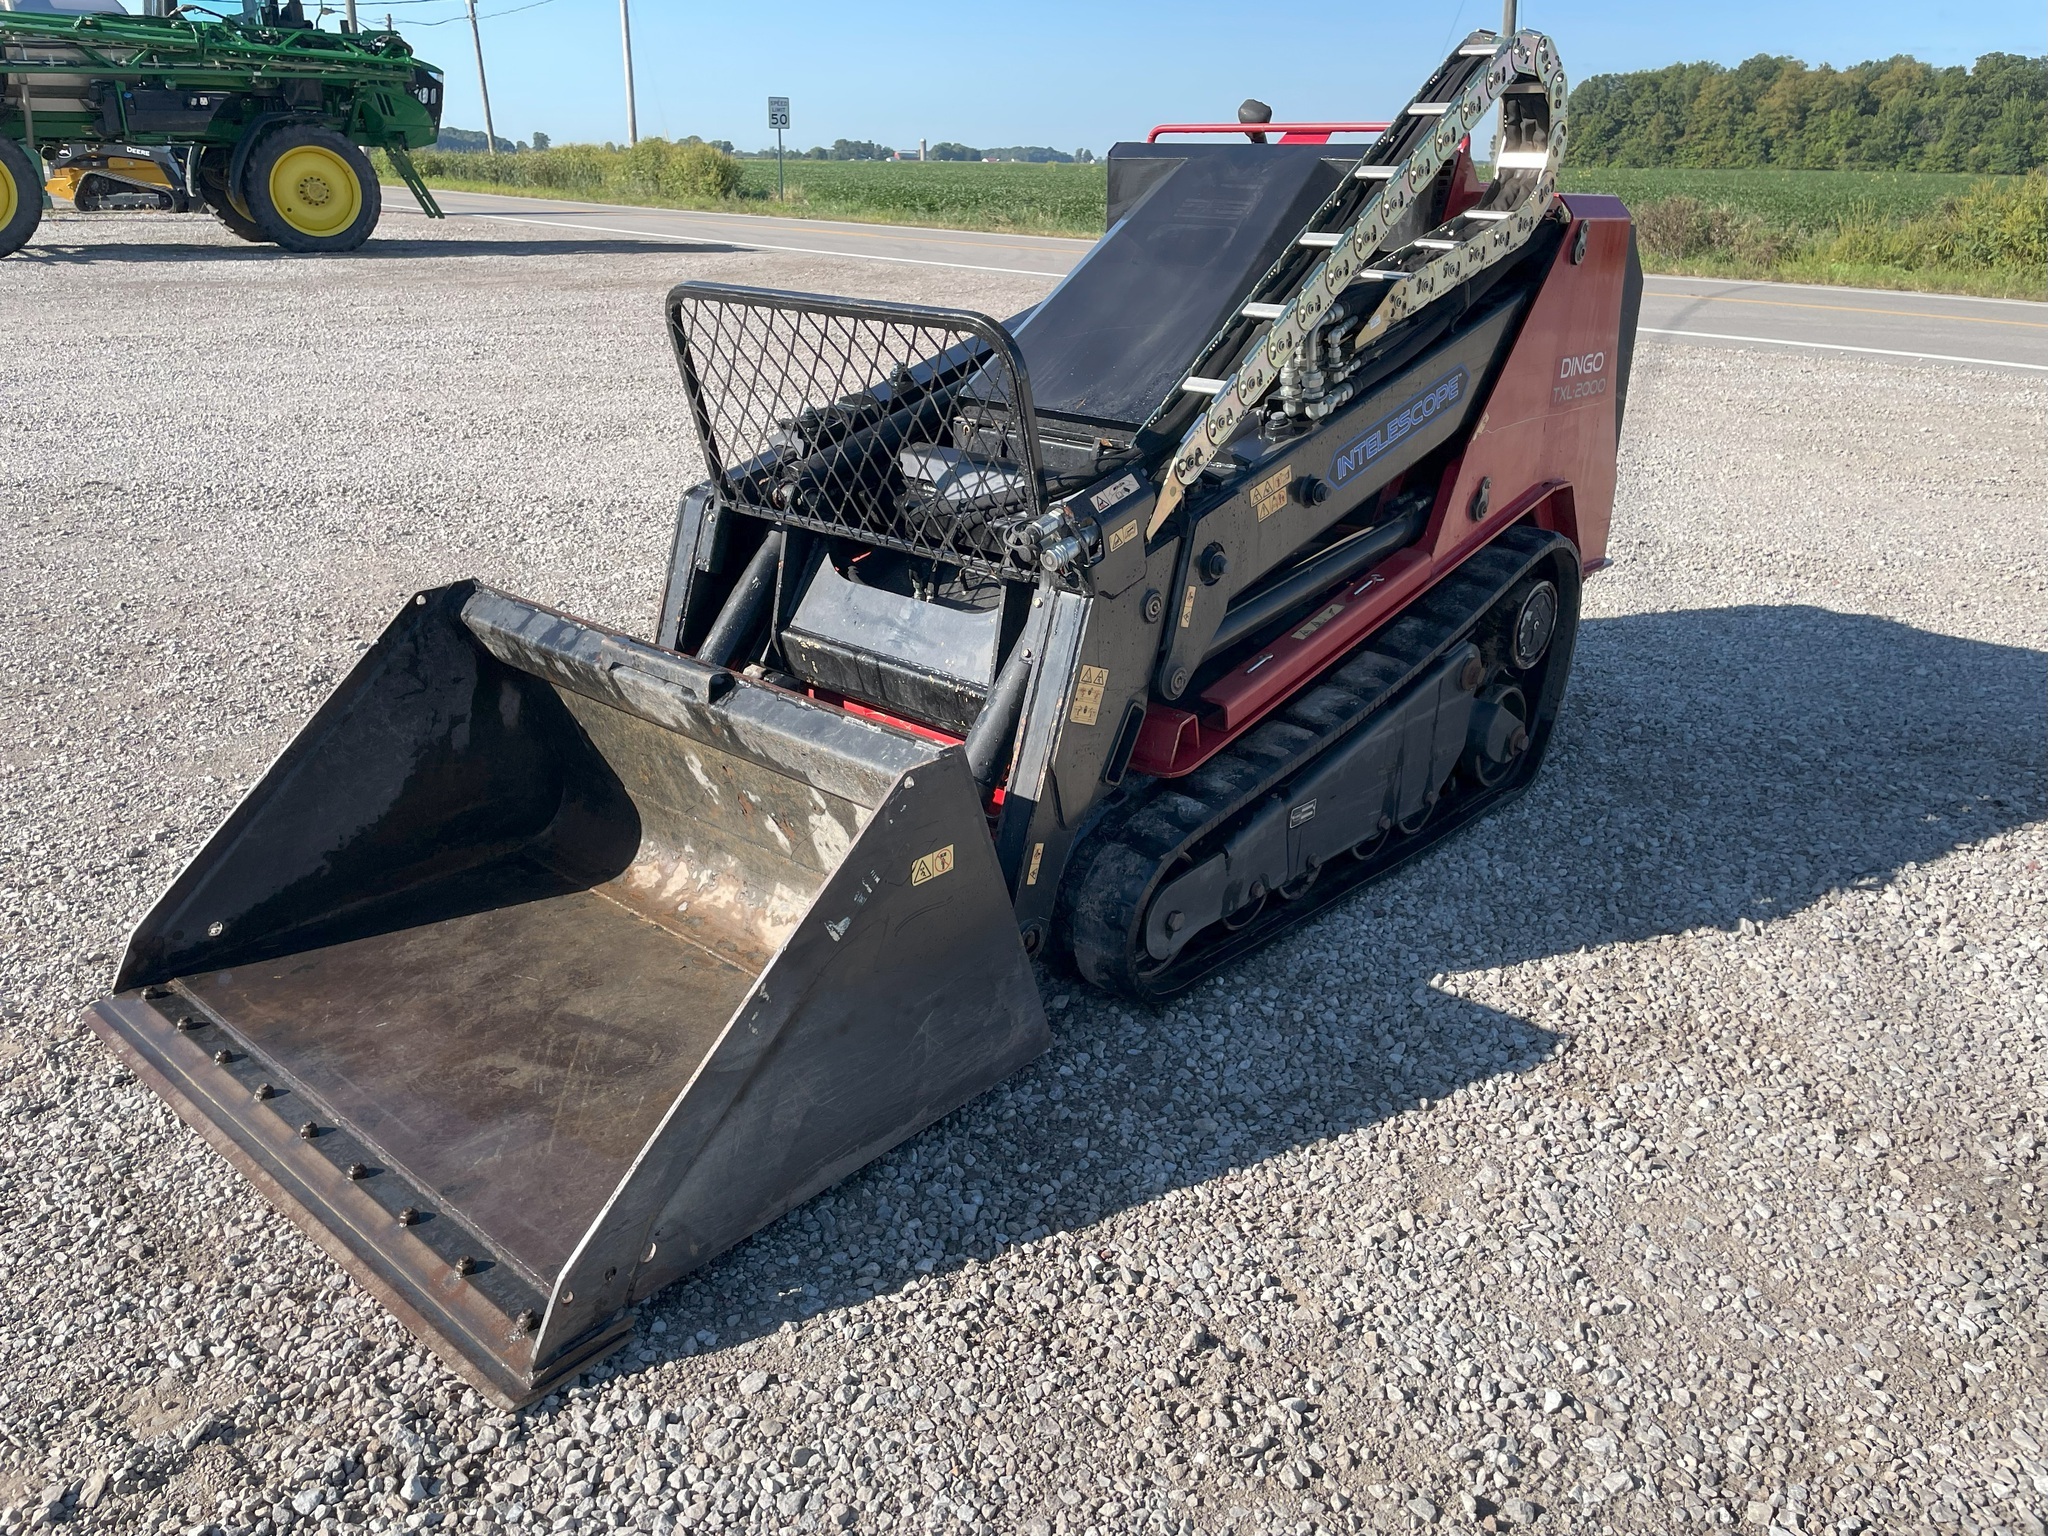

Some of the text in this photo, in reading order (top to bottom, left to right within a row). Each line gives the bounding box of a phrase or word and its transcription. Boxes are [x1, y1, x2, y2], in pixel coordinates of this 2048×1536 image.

[771, 114, 788, 125] 50
[127, 146, 150, 157] DEERE
[1560, 352, 1604, 379] DINGO
[1337, 375, 1459, 480] INTELESCOPE
